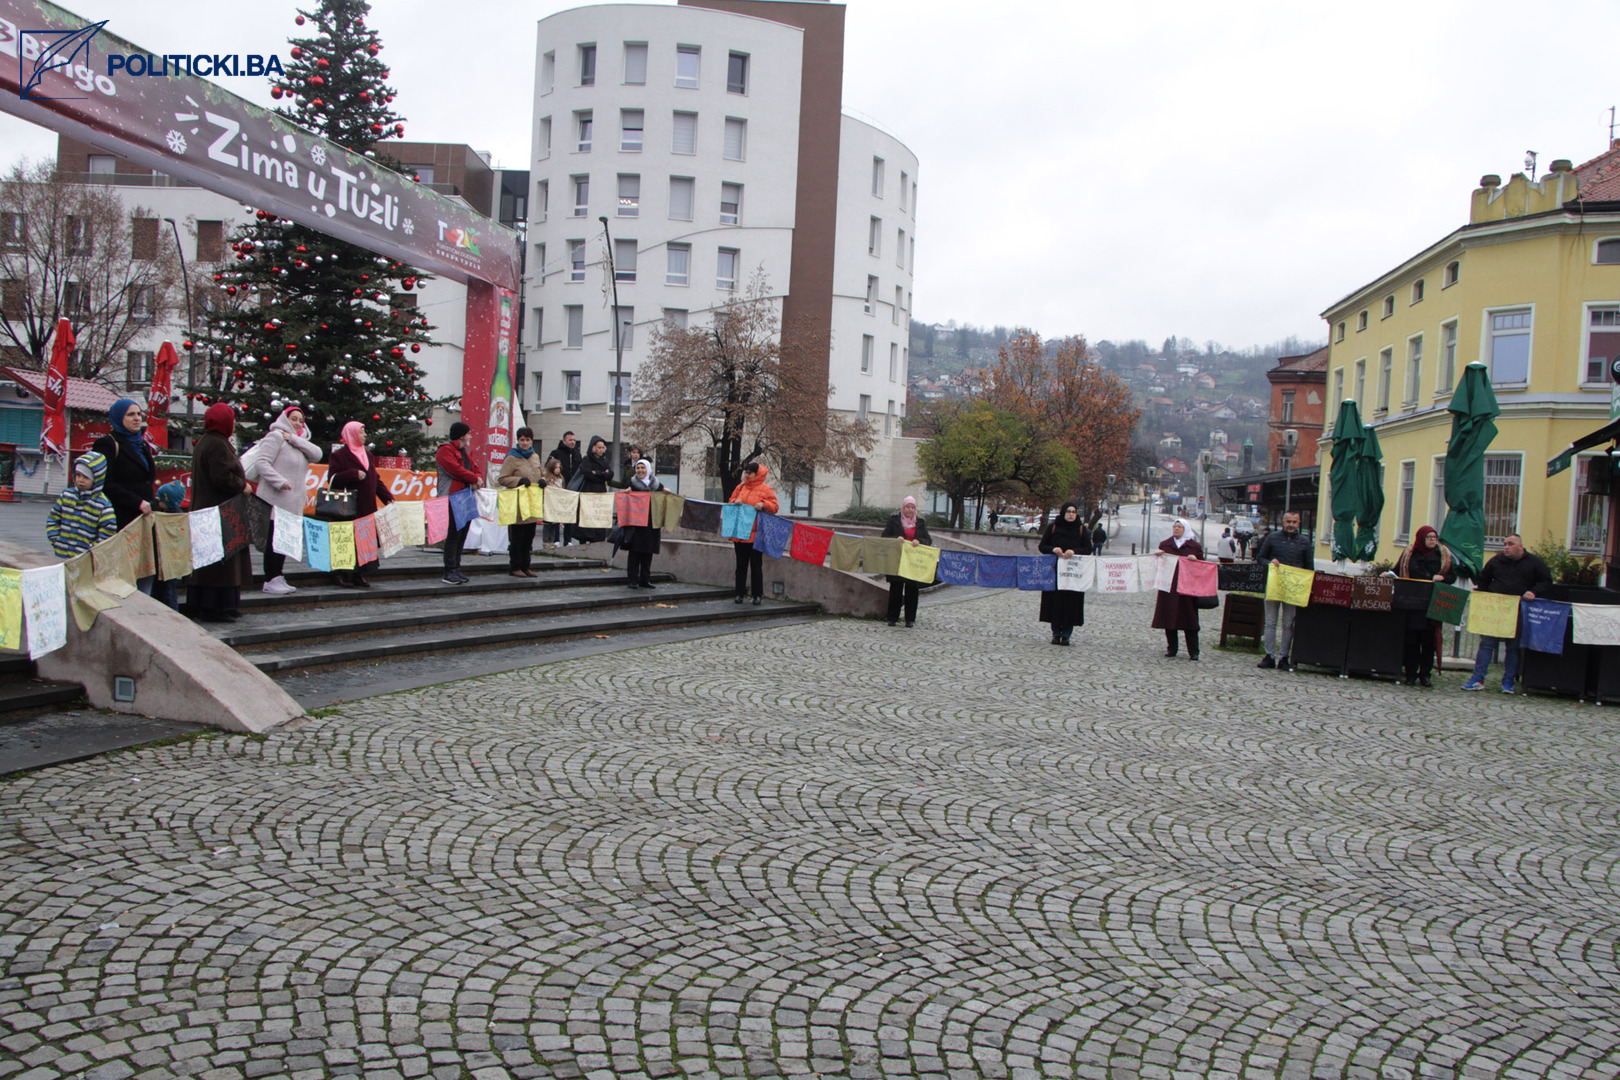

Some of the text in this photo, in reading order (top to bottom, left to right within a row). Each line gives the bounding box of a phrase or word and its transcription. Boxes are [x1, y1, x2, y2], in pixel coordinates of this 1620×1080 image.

[21, 36, 116, 96] Bingo
[205, 111, 399, 231] Zima u Tuzli
